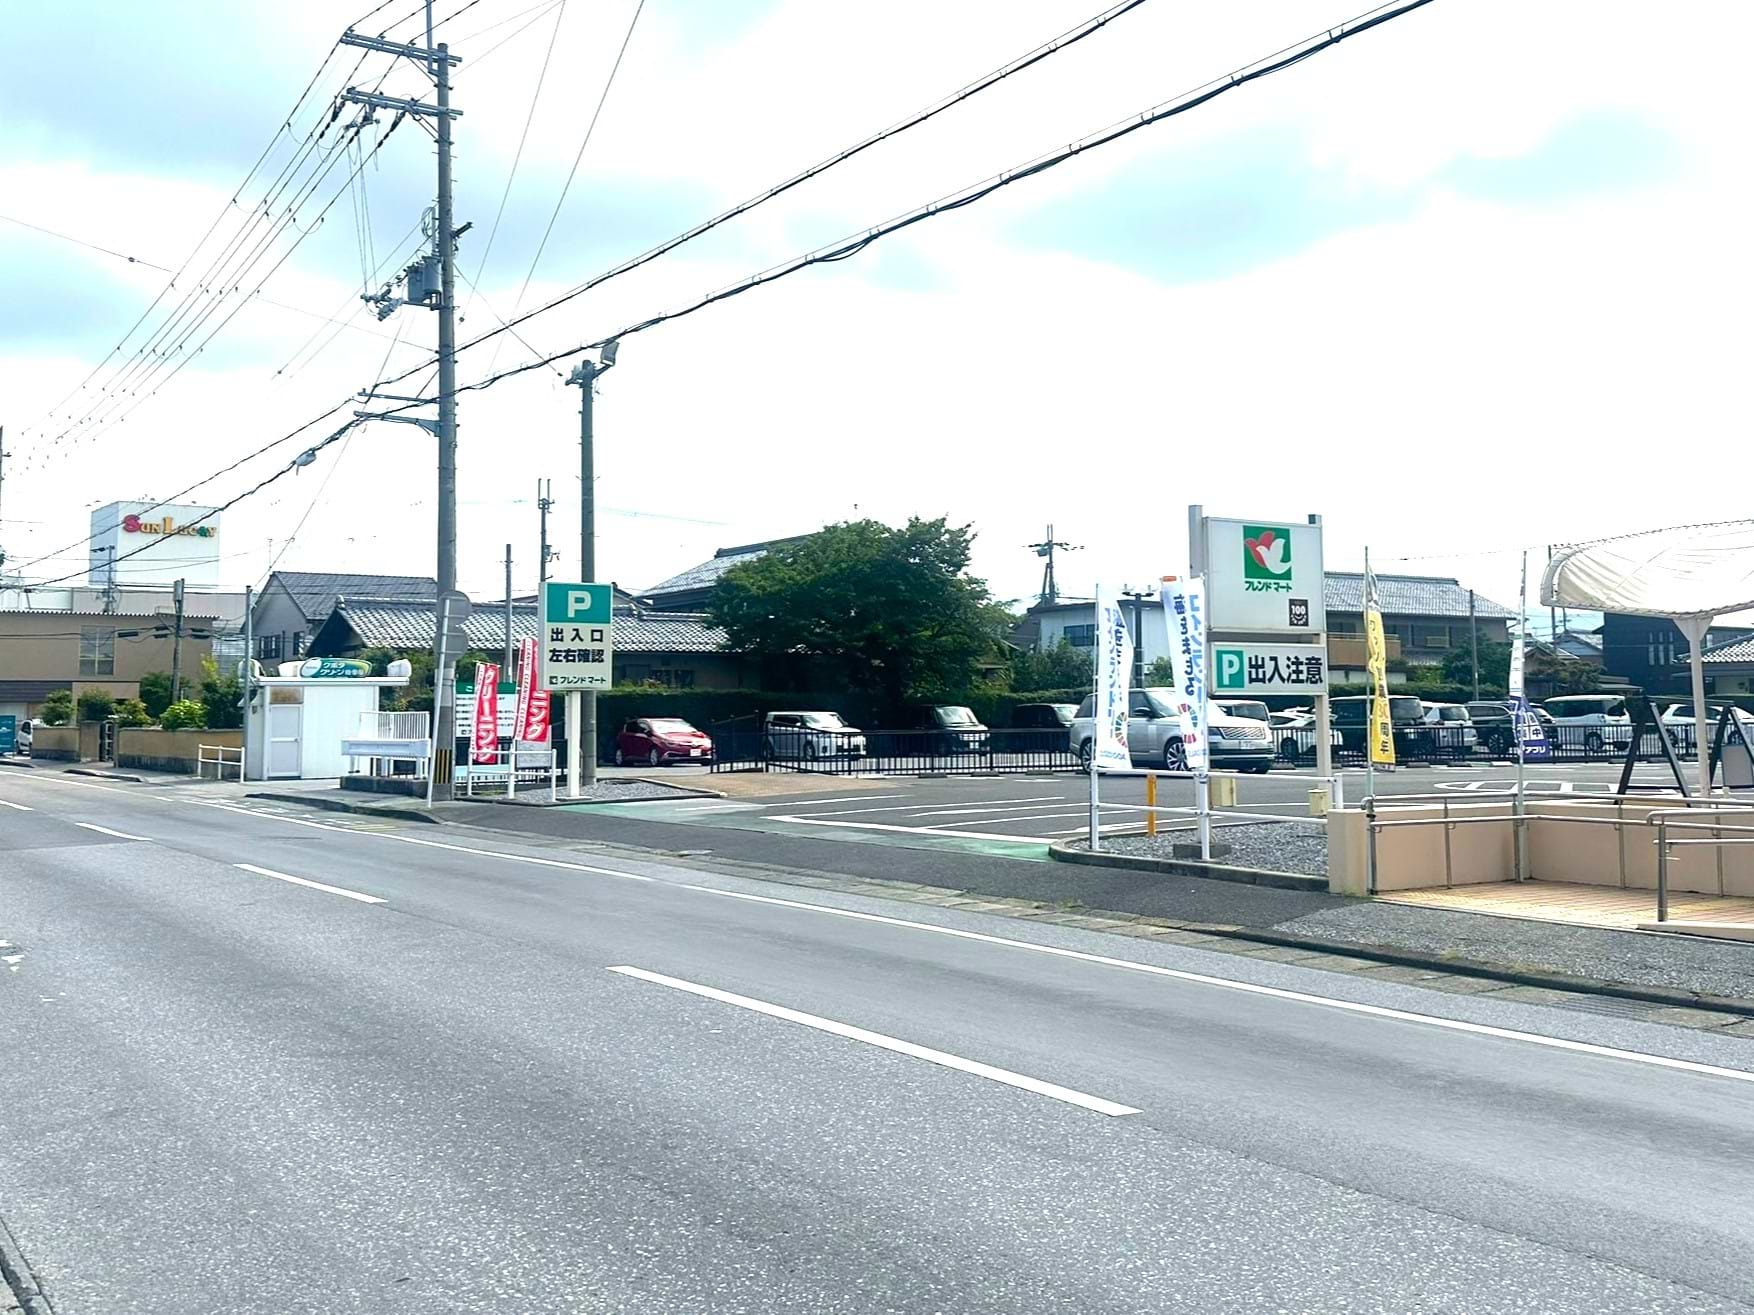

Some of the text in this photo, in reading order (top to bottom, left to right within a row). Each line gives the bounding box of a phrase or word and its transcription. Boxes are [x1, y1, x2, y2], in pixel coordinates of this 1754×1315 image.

[1244, 580, 1293, 593] フレンドマート
[567, 590, 592, 618] P
[1291, 605, 1306, 615] 100
[550, 627, 604, 643] 出入口
[549, 648, 605, 663] 左右確認
[1222, 653, 1241, 685] P
[1248, 654, 1324, 686] 出入注意
